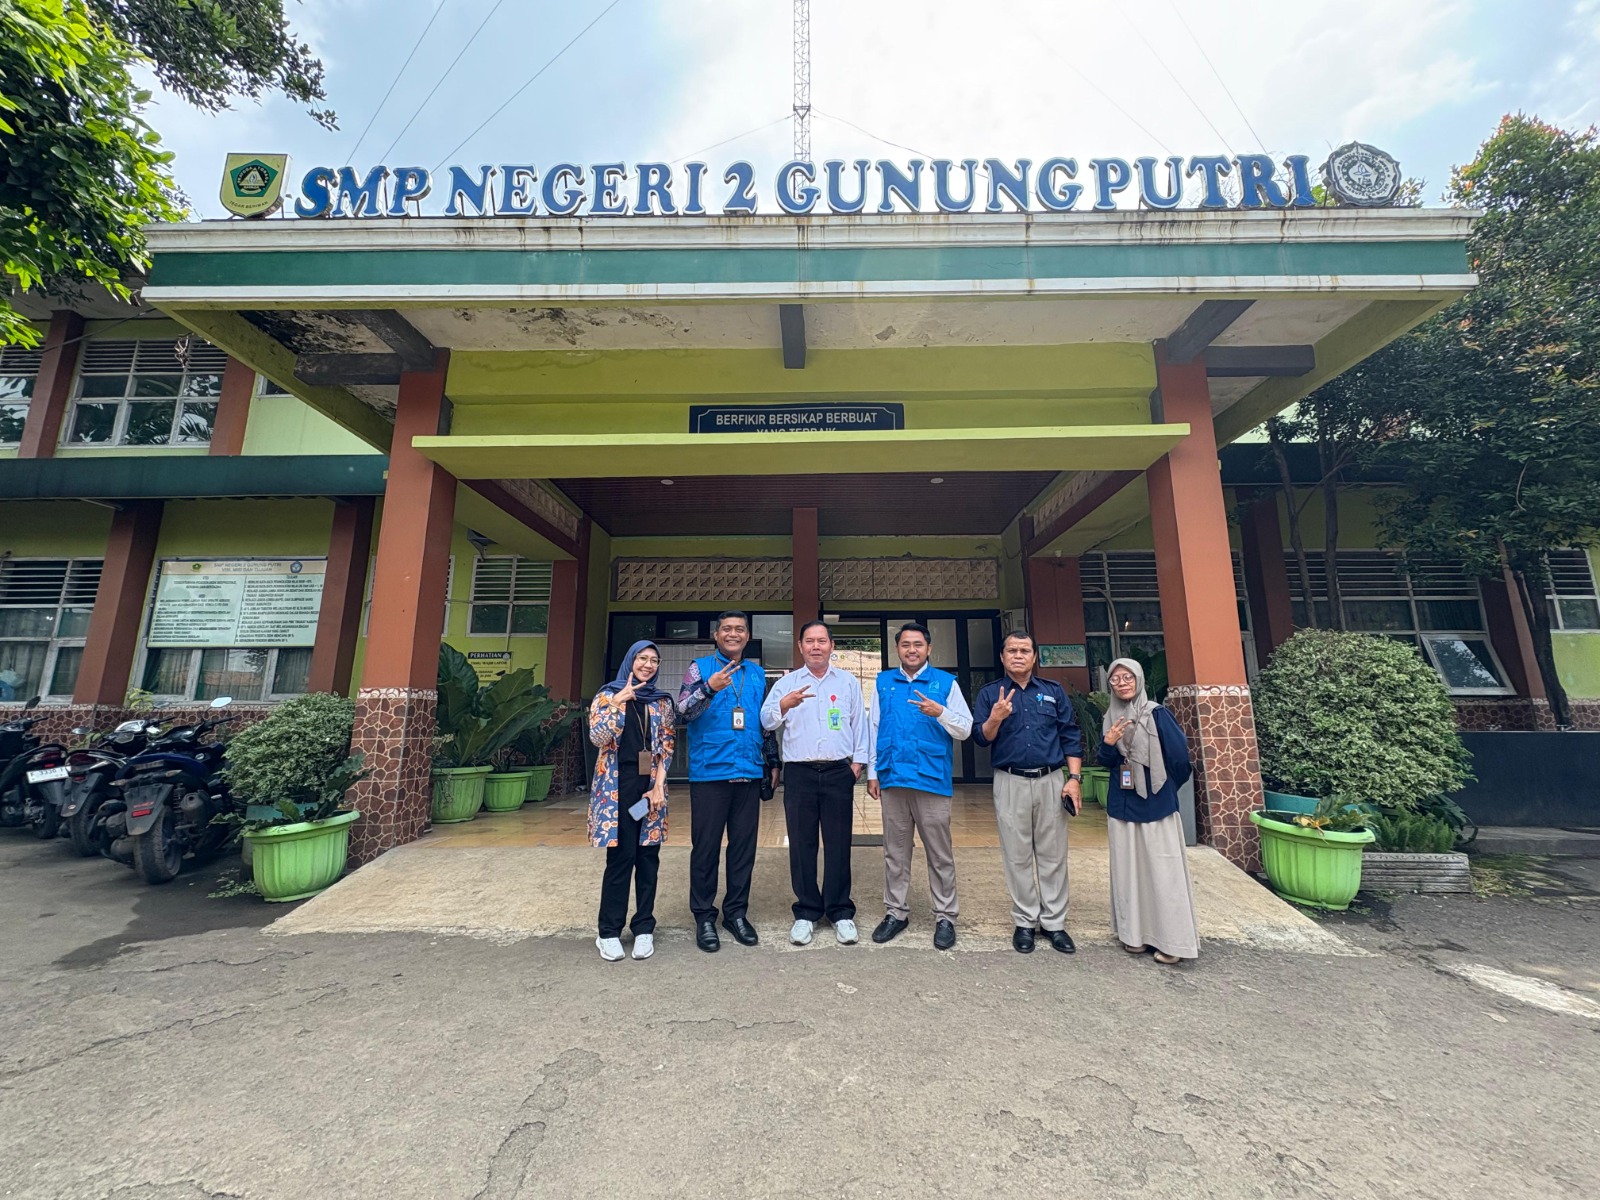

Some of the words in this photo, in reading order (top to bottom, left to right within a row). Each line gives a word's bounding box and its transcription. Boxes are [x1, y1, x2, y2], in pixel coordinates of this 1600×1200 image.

[295, 165, 431, 219] SMP
[447, 161, 708, 217] NEGERI
[721, 159, 757, 216] 2
[716, 414, 766, 426] BERFIKIR
[768, 412, 824, 425] BERSIKAP
[826, 412, 878, 424] BERBUAT
